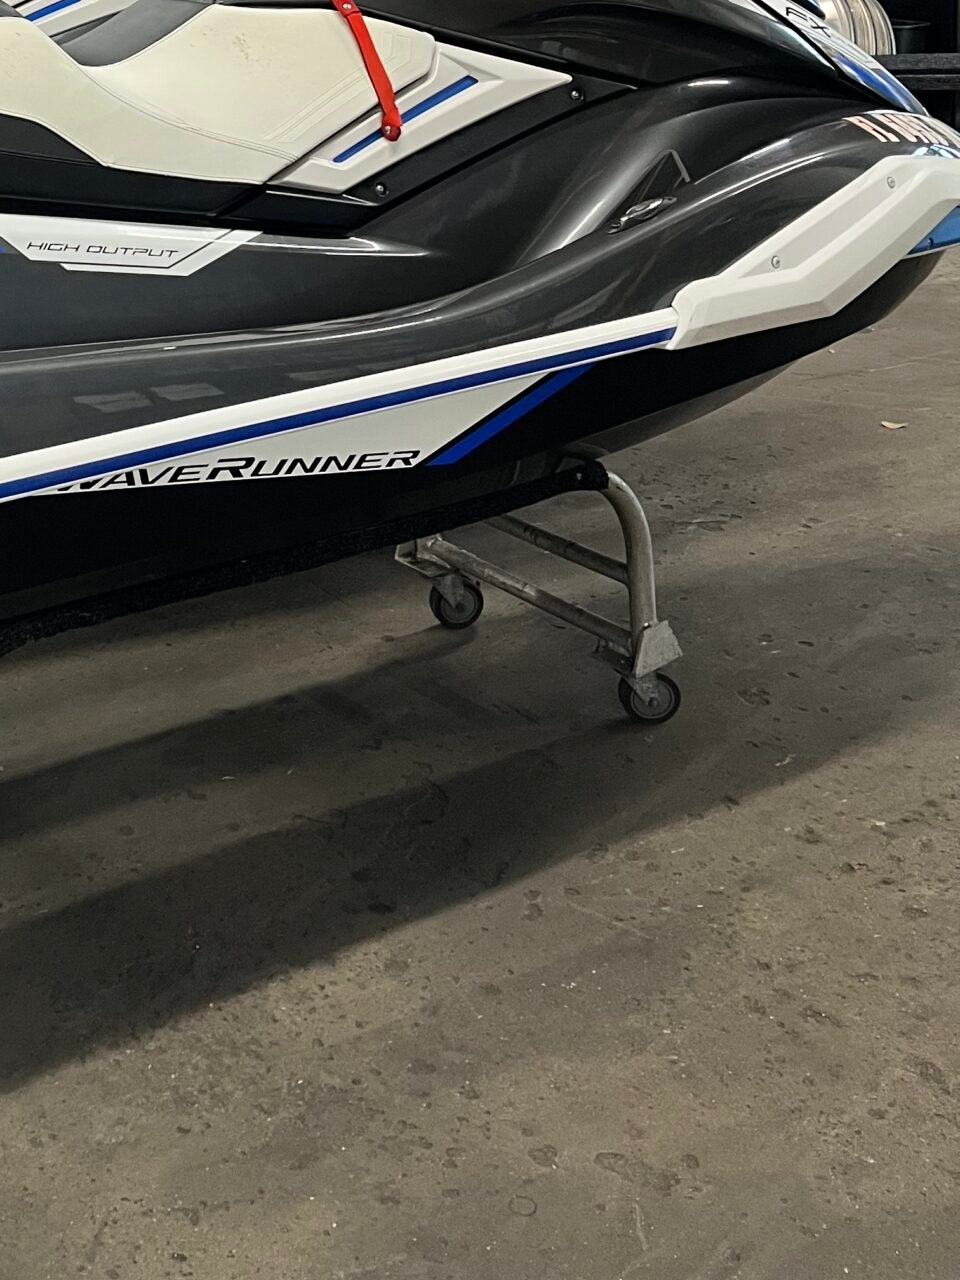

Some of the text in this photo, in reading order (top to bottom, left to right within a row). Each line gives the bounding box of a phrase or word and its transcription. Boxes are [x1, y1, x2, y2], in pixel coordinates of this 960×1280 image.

[785, 6, 832, 39] FX
[26, 240, 179, 259] HIGH OUTPUT
